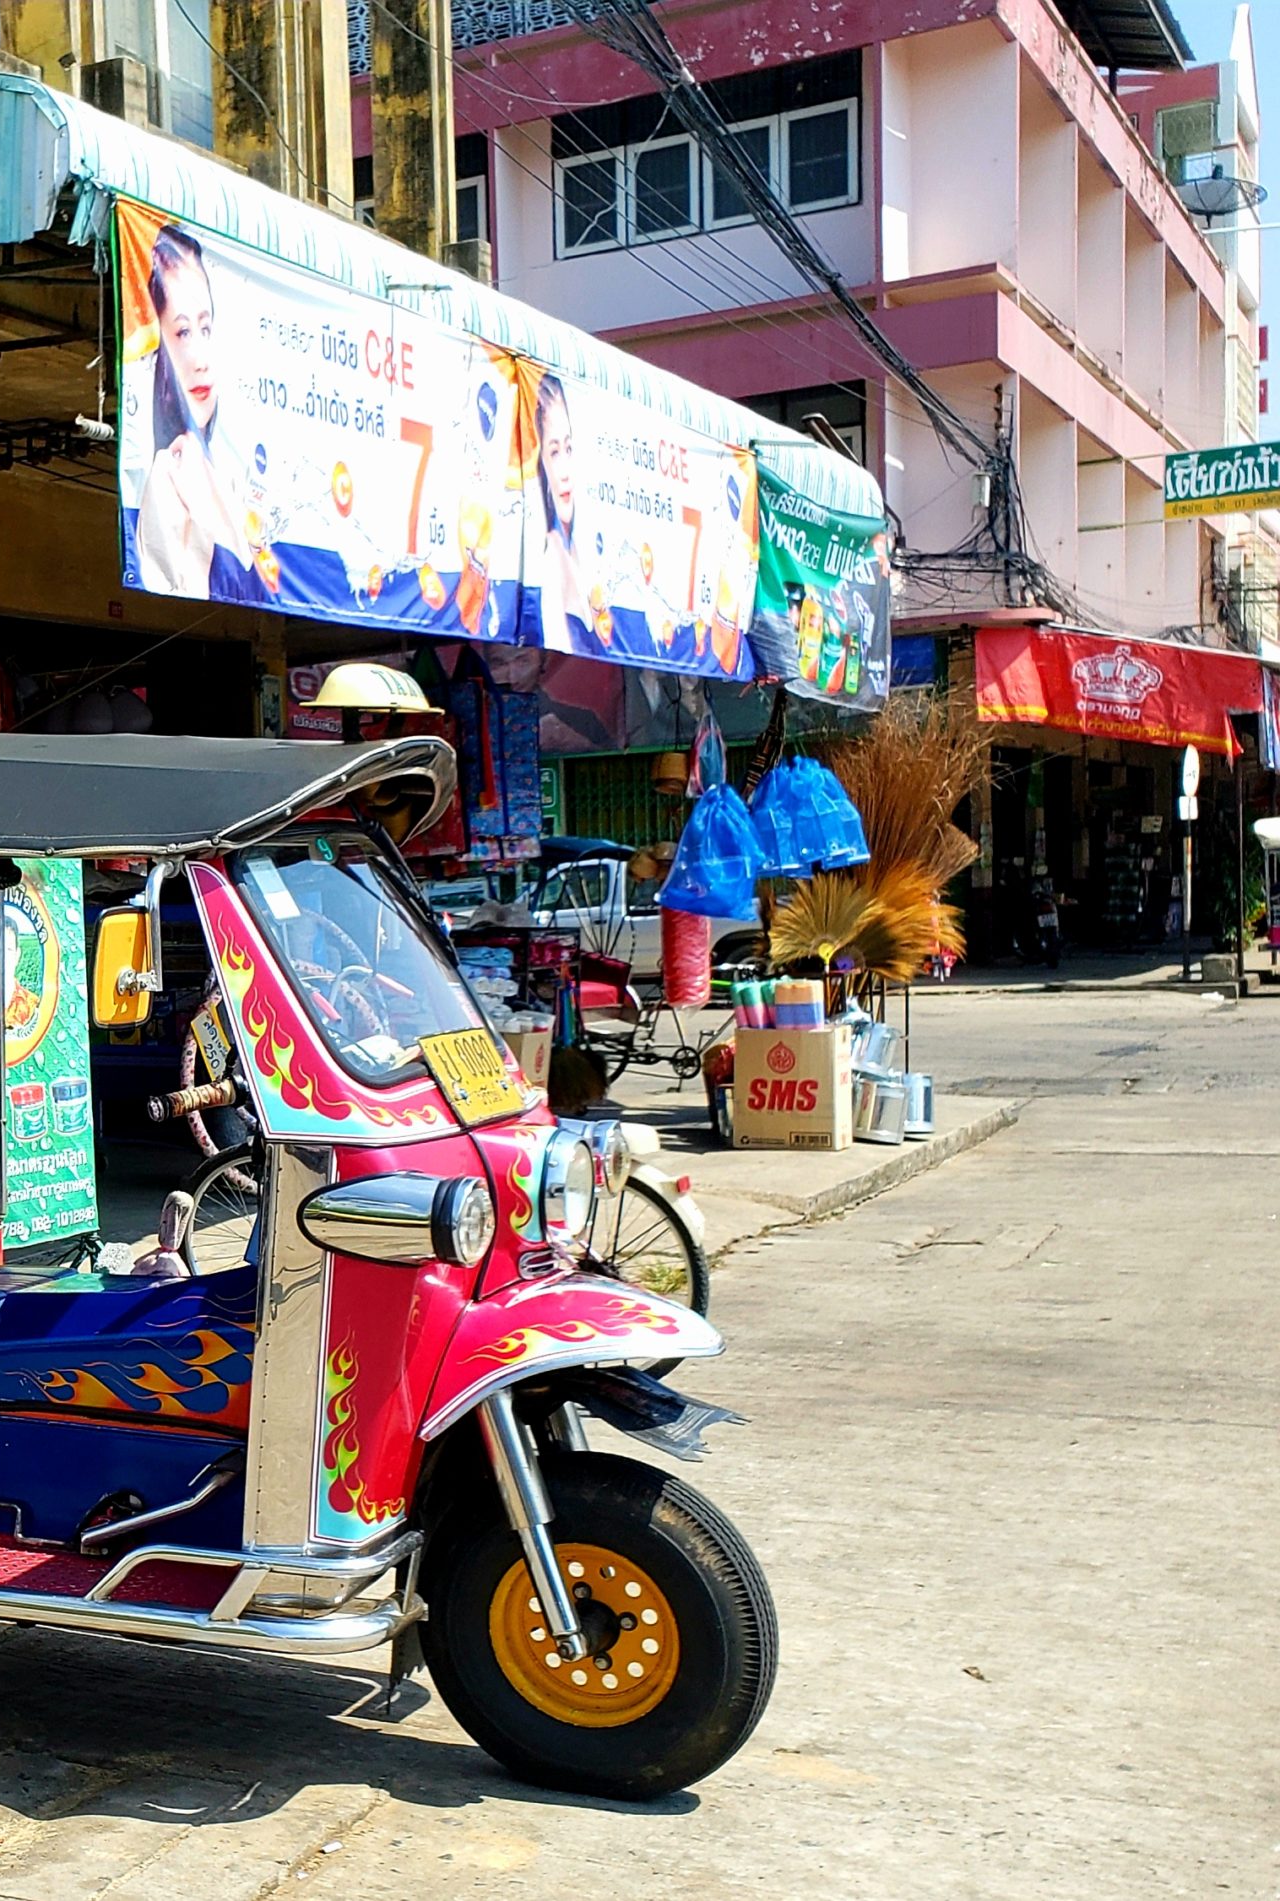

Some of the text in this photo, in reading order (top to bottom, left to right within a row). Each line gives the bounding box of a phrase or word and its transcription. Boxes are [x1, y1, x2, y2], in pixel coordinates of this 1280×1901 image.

[365, 329, 414, 389] C&E
[658, 439, 689, 484] C&E
[400, 417, 433, 554] 7
[682, 505, 702, 611] 7
[316, 838, 333, 861] 9
[203, 1043, 221, 1069] 250
[747, 1077, 819, 1112] SMS
